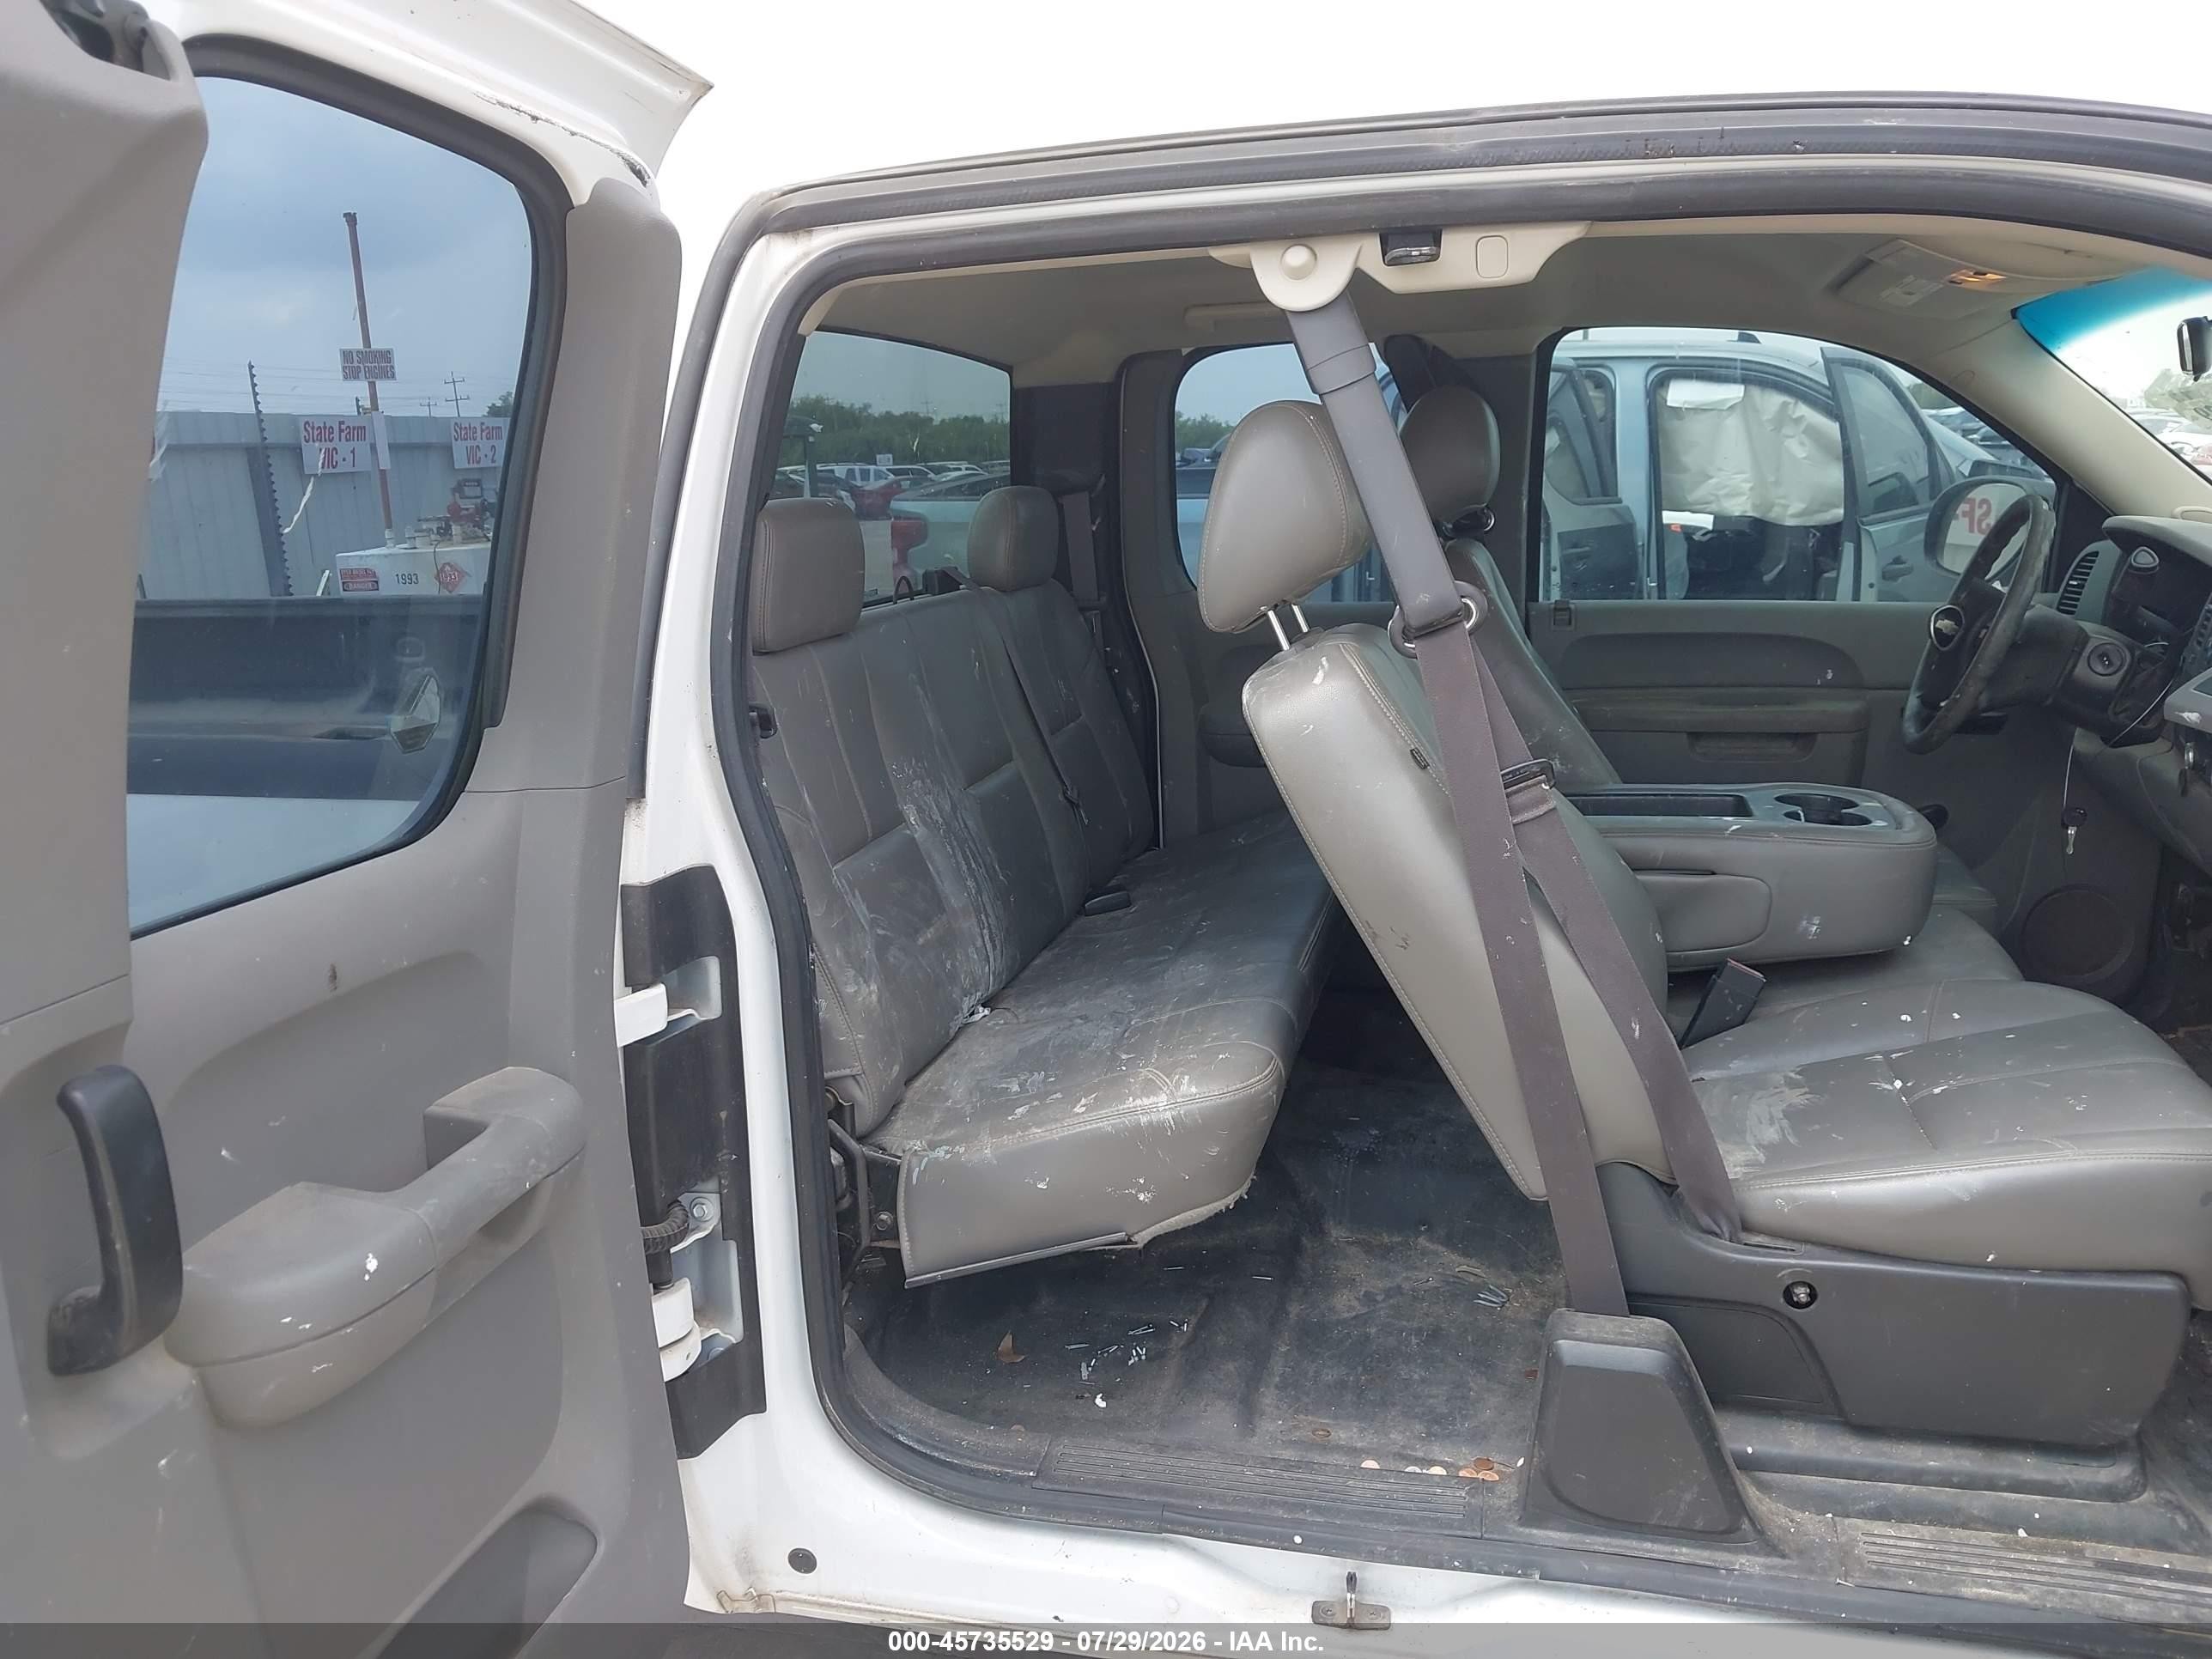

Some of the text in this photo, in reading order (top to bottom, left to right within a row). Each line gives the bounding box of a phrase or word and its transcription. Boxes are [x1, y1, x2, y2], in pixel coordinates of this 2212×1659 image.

[343, 350, 392, 364] NO SMOKING
[343, 365, 395, 380] STOP ENGINES
[303, 420, 367, 443] State Farm
[453, 422, 503, 442] State Farm
[319, 447, 338, 469] VIC
[350, 447, 356, 468] 1
[466, 445, 482, 465] VIC
[490, 445, 496, 464] 2
[395, 573, 419, 585] 1993
